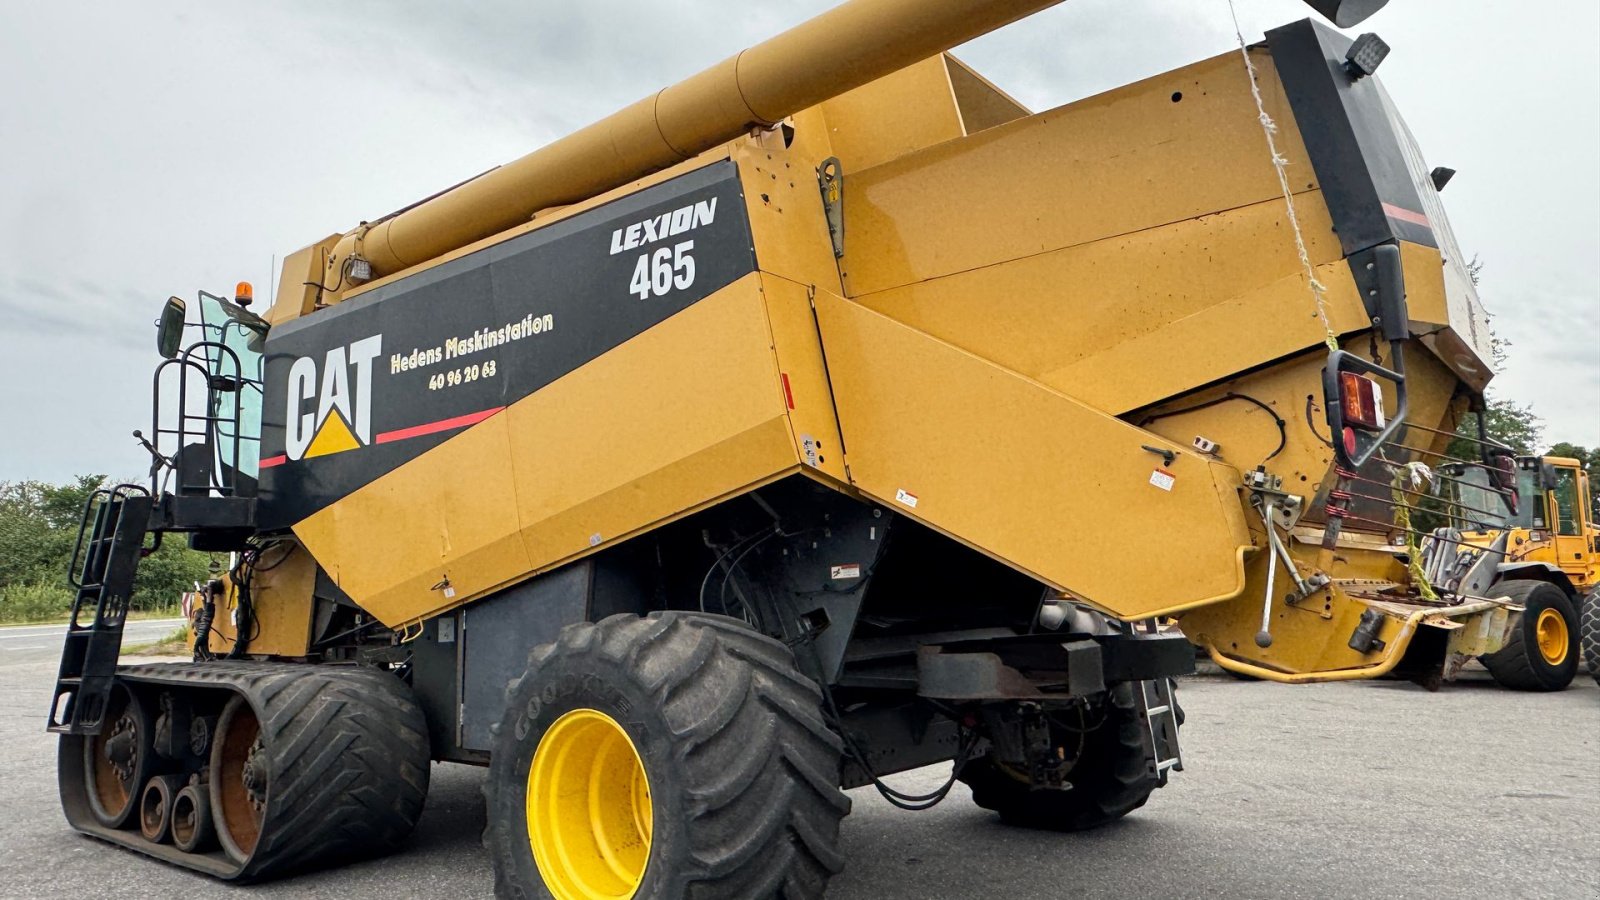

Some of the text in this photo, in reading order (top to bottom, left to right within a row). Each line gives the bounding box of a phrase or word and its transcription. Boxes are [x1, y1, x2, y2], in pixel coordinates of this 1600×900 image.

[610, 197, 718, 255] LEXION
[629, 240, 696, 300] 465
[390, 313, 553, 374] Hedens Maskinstation
[286, 334, 382, 461] CAT
[428, 360, 497, 391] 40 96 20 63
